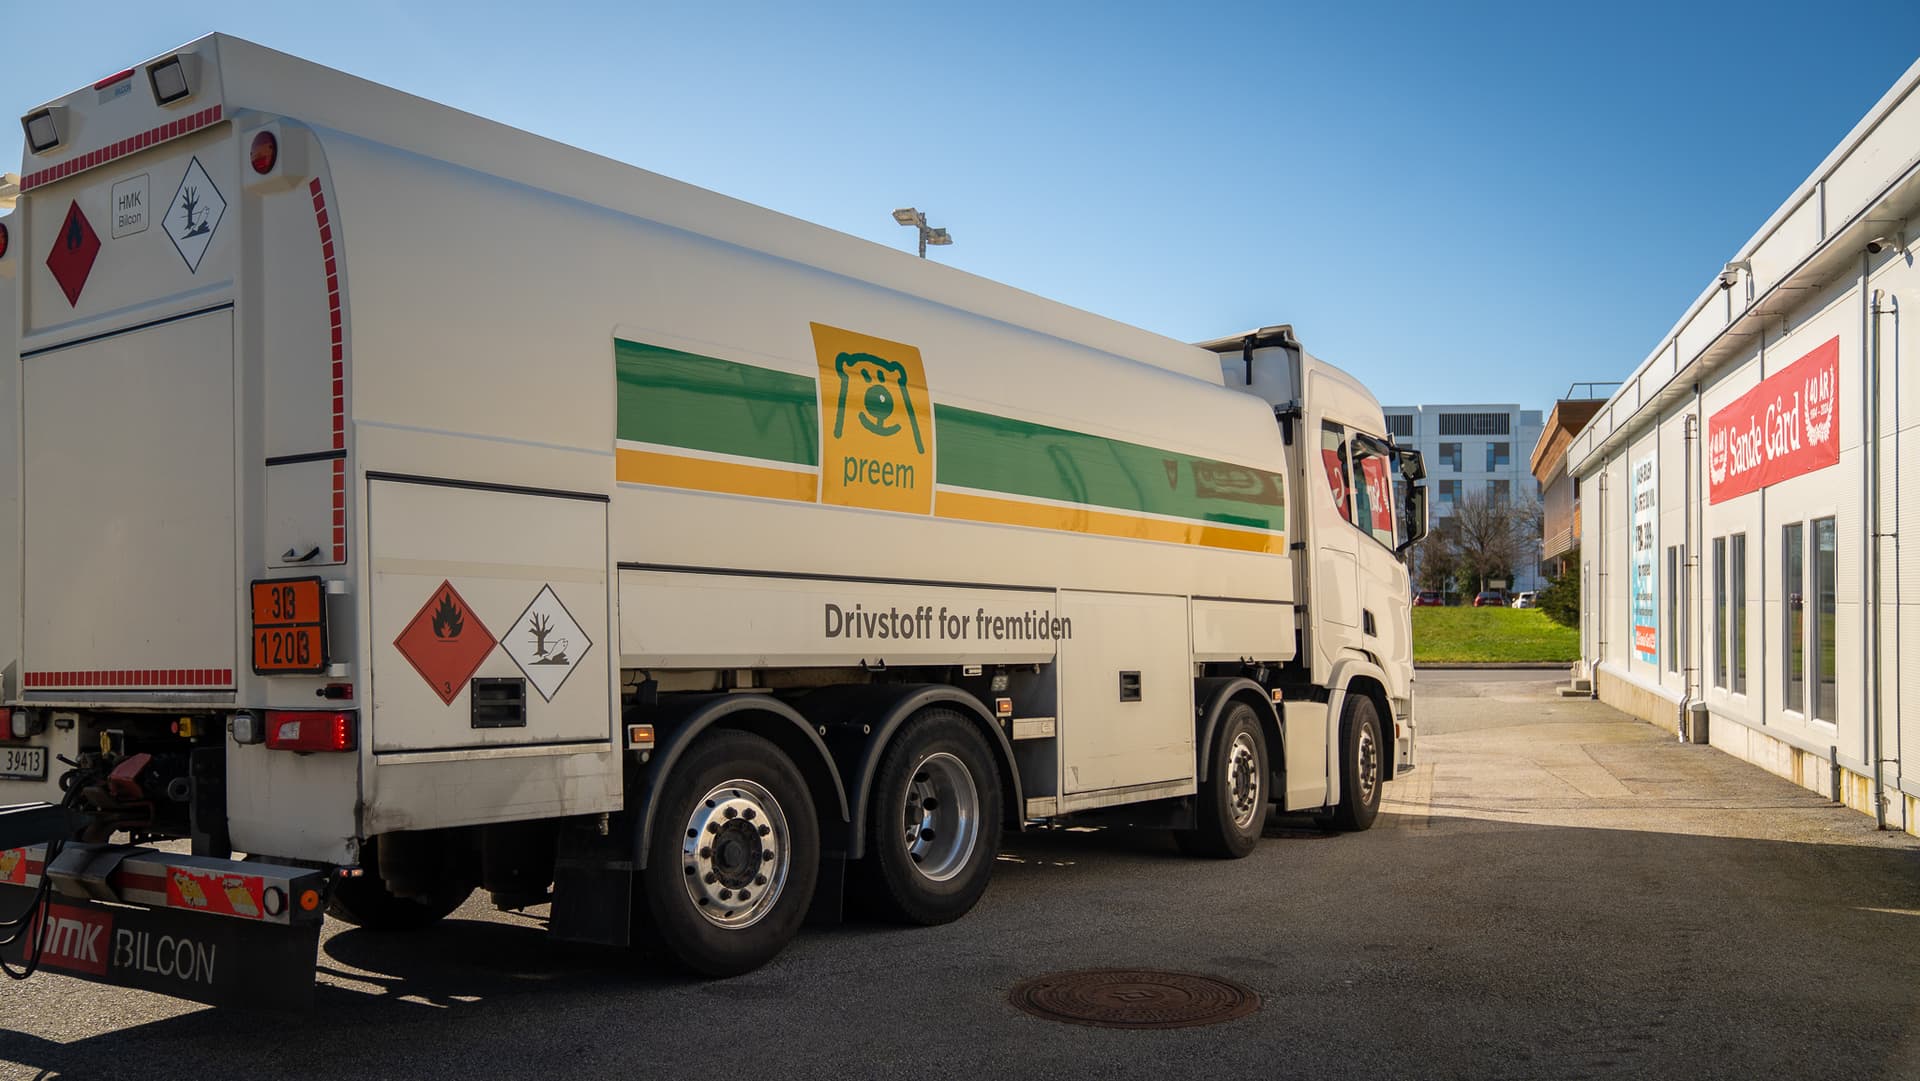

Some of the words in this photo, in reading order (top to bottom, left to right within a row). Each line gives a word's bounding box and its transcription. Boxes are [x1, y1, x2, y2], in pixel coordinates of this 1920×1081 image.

[118, 190, 142, 211] HMK
[118, 213, 142, 228] Bilcon
[1730, 415, 1762, 476] Sande
[1765, 391, 1801, 461] Gård
[843, 456, 915, 489] preem
[271, 586, 296, 620] 33
[824, 603, 933, 640] Drivstoff
[939, 606, 970, 640] for
[976, 608, 1073, 640] fremtiden
[261, 630, 310, 665] 1203
[443, 681, 451, 695] 3
[6, 751, 40, 771] 39413
[113, 928, 216, 985] BILCON
